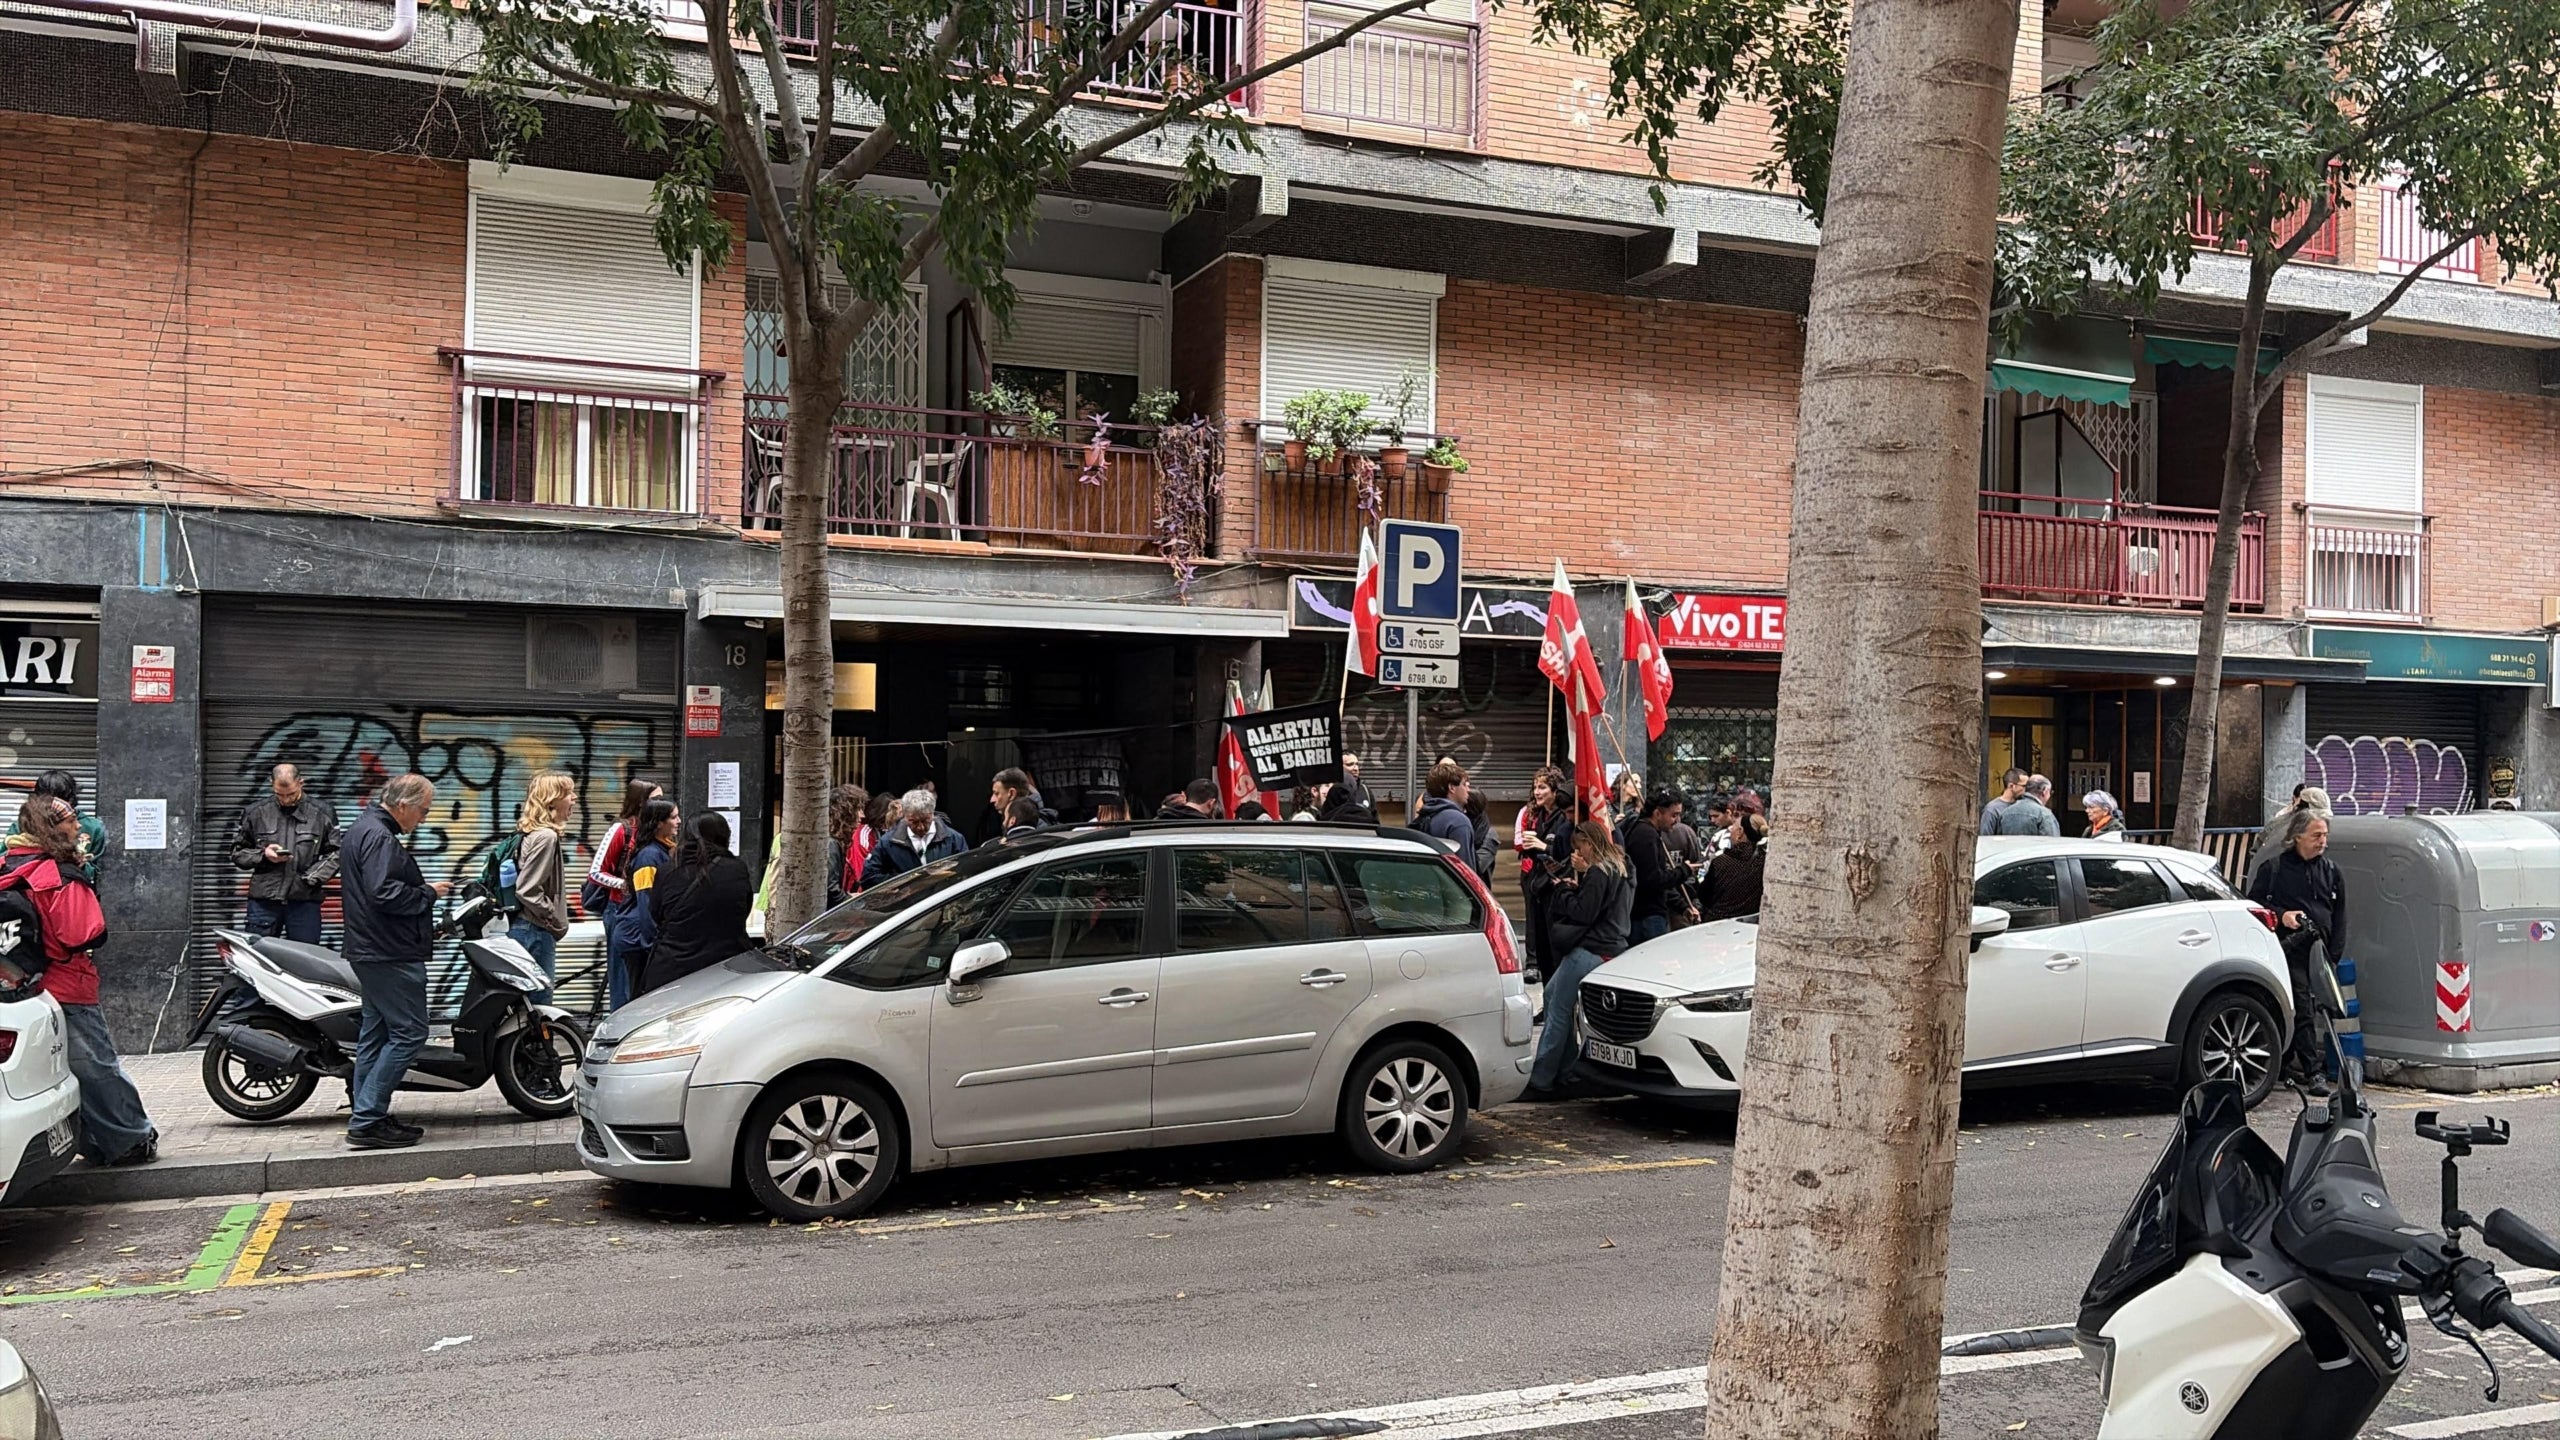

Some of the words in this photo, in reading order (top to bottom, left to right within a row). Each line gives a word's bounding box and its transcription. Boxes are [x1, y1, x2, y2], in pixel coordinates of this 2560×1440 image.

[1397, 533, 1446, 608] P
[1670, 595, 1786, 640] VivoTE
[1409, 638, 1427, 649] 4705
[1428, 639, 1445, 649] GSF
[725, 644, 746, 666] 18
[135, 669, 171, 678] Alarma
[1224, 662, 1240, 679] 16
[1408, 673, 1426, 684] 6798
[1432, 675, 1448, 685] KJD
[689, 706, 718, 715] Alarma
[1246, 717, 1330, 746] ALERTA!
[1250, 736, 1330, 757] DESNONAMENT
[1256, 756, 1278, 773] AL
[1281, 748, 1333, 770] BARRI
[1591, 1042, 1611, 1060] 6798
[1613, 1048, 1633, 1066] KJD
